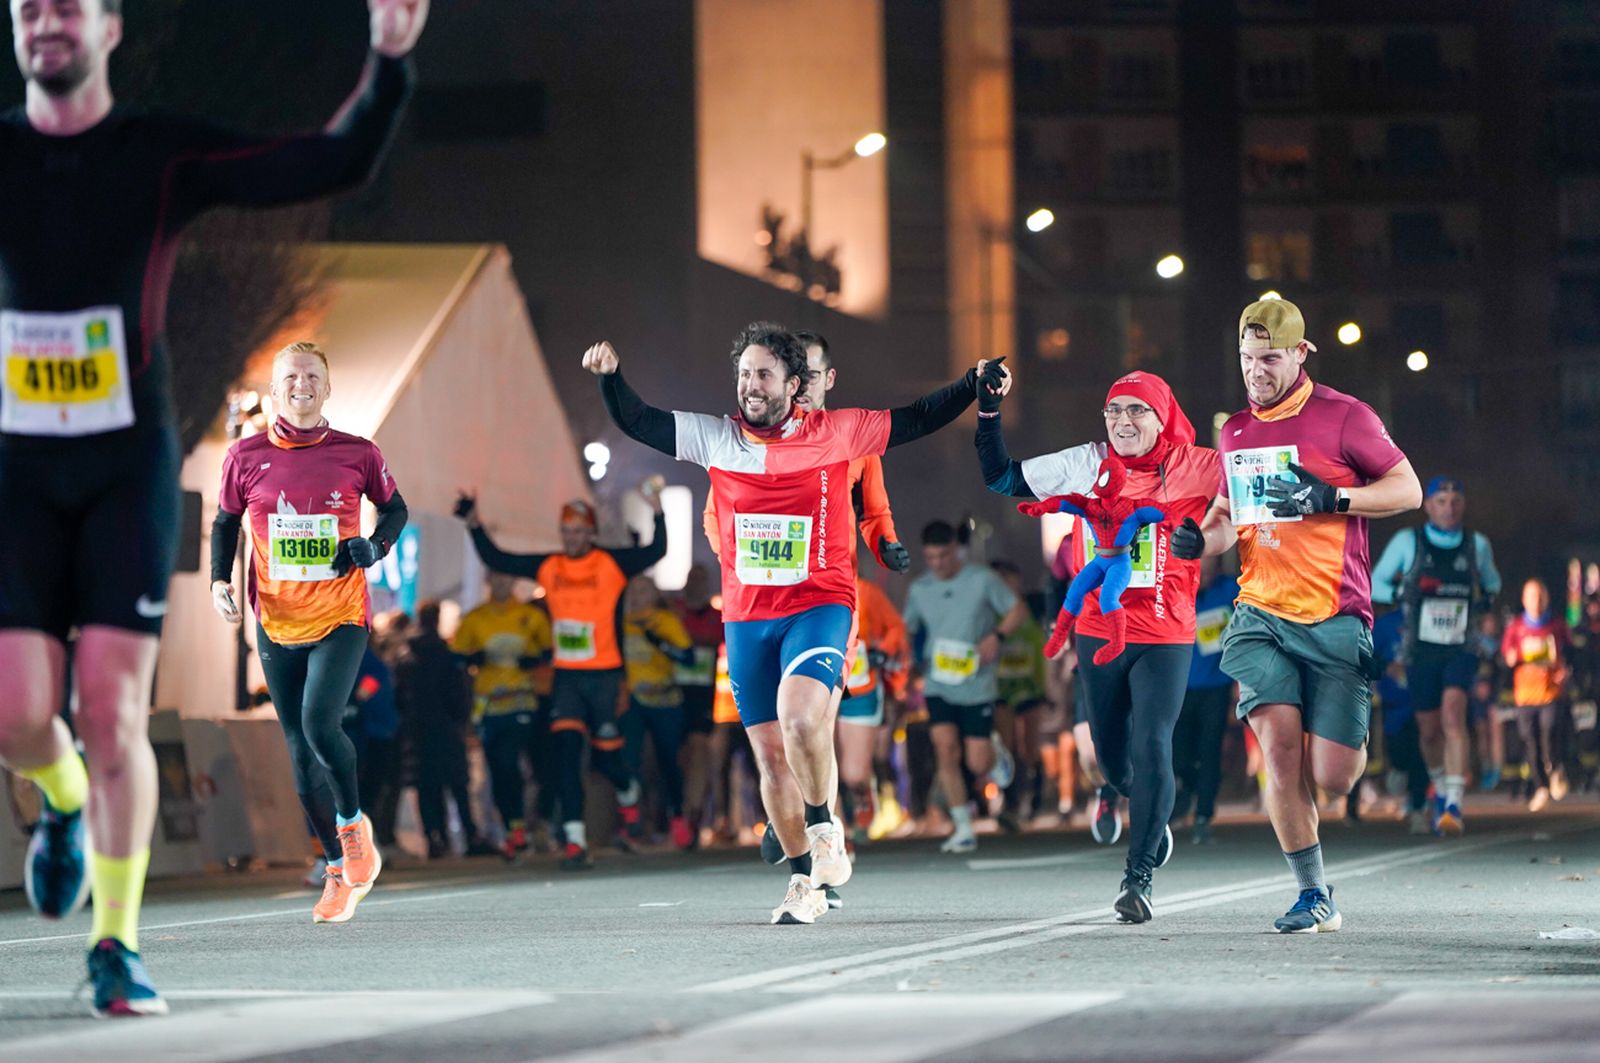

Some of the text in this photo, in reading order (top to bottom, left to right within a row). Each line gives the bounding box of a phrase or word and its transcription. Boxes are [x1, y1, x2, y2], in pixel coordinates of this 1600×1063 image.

[26, 358, 99, 392] 4196
[305, 522, 313, 530] DE
[750, 522, 771, 530] NOCHE
[278, 538, 330, 558] 13168
[751, 540, 793, 561] 9144
[1155, 584, 1166, 619] BAILÉN
